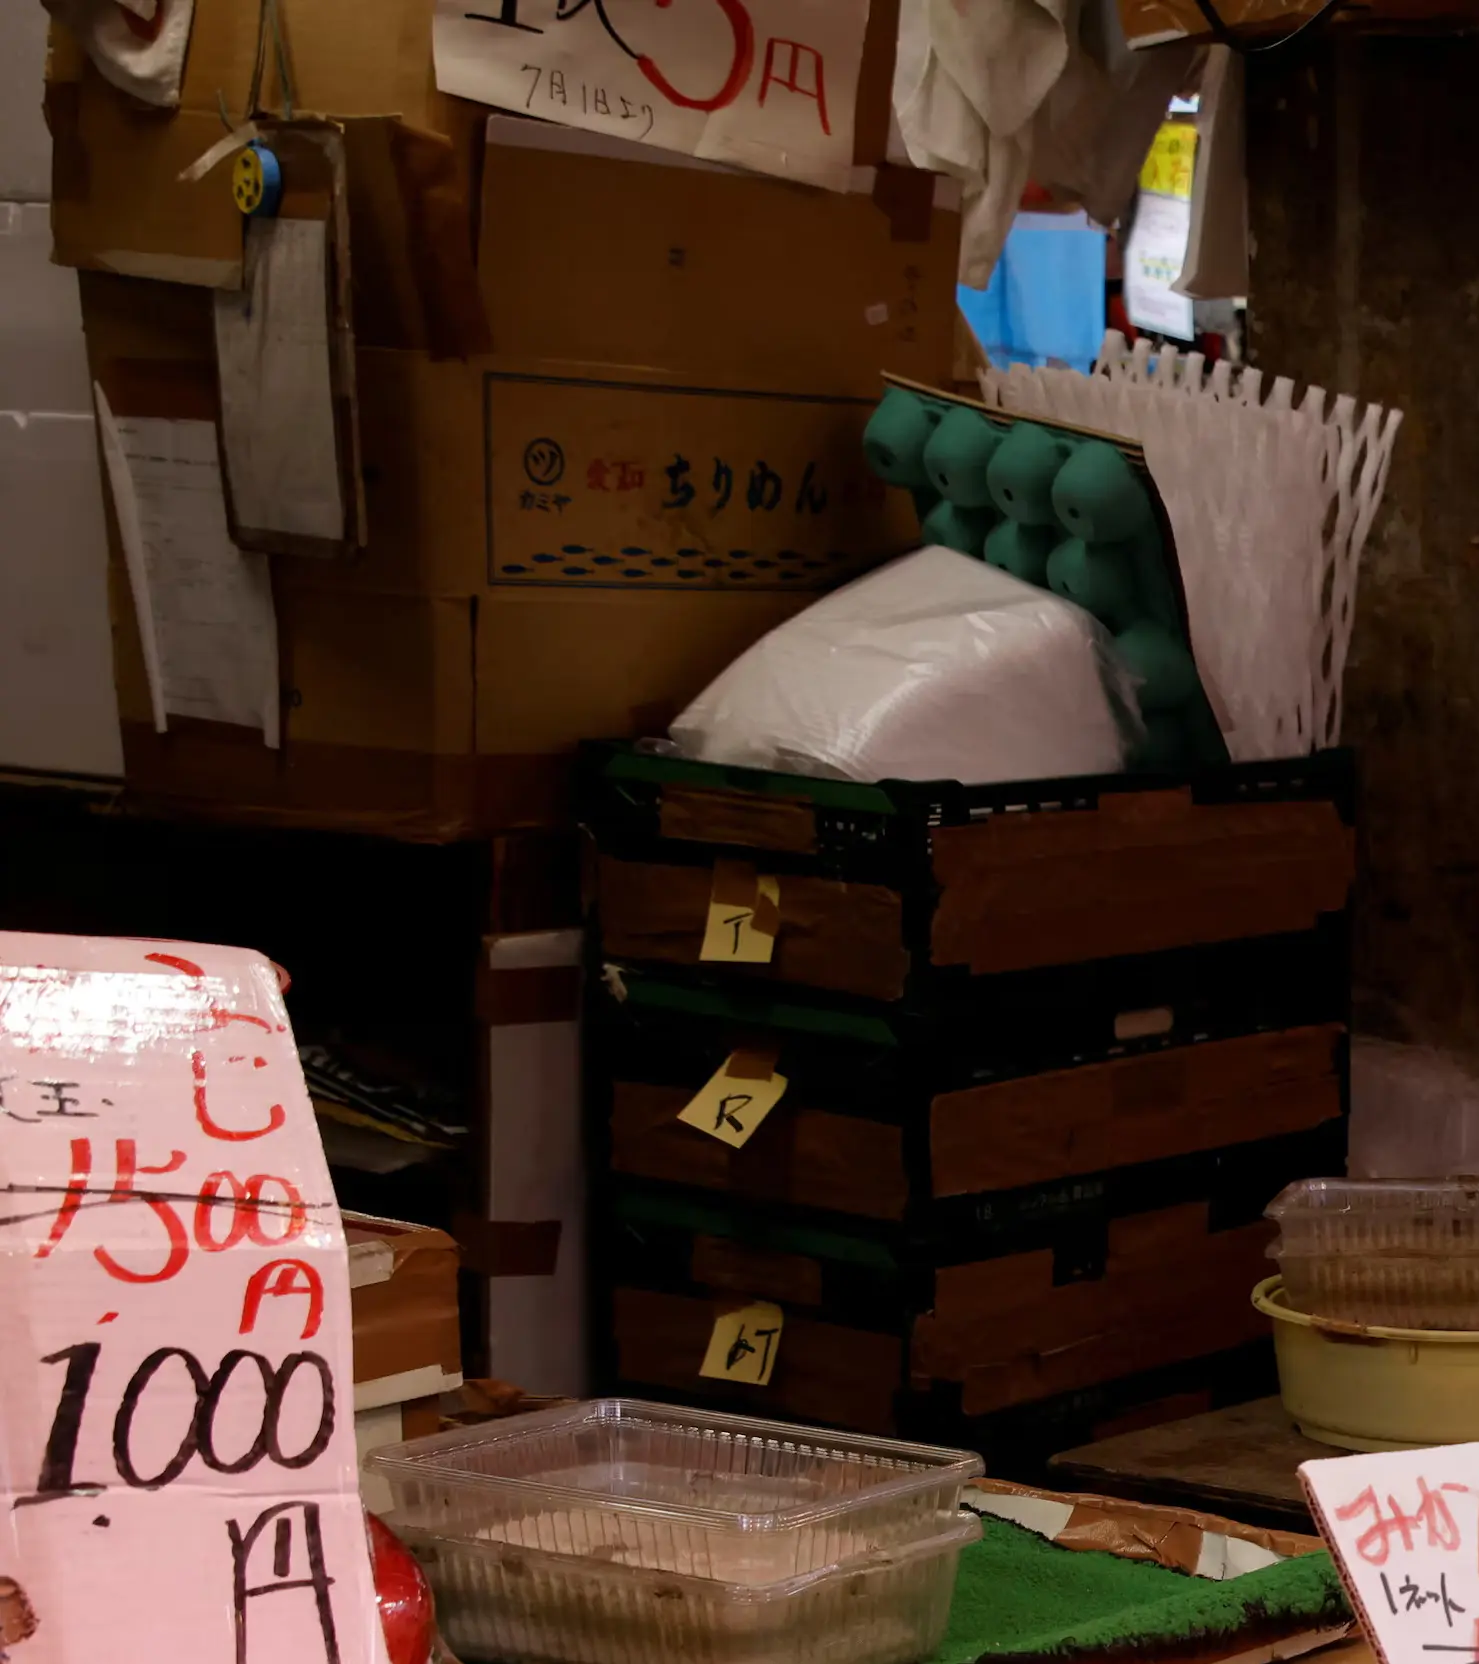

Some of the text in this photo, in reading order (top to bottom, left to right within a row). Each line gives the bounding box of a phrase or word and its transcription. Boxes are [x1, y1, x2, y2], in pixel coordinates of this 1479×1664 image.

[662, 452, 829, 514] ちりめん
[714, 1093, 753, 1134] R
